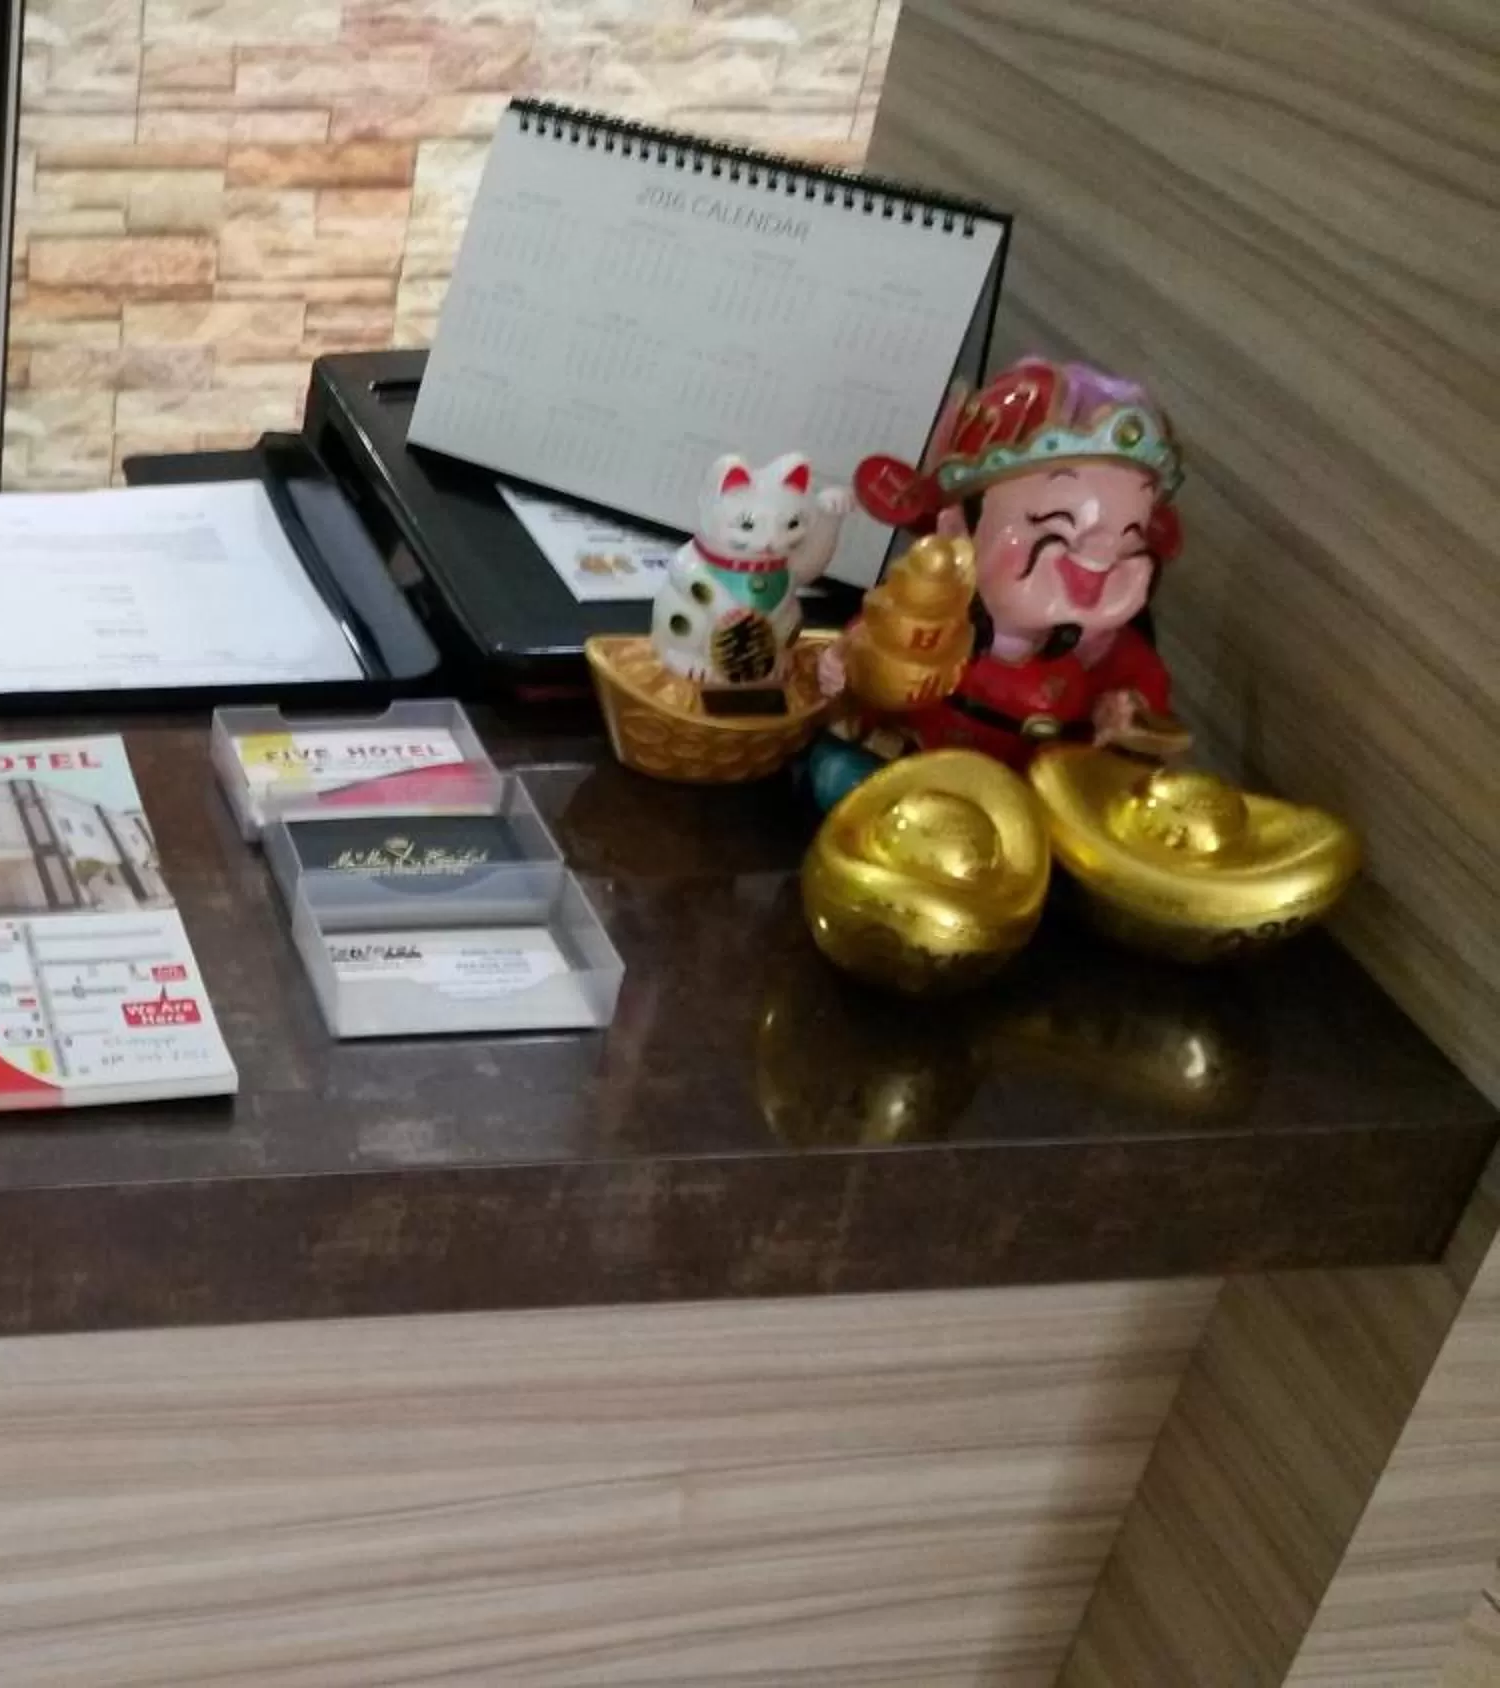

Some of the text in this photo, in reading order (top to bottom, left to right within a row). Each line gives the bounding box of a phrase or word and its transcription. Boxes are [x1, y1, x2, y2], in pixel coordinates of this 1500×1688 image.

[691, 194, 811, 245] CALENDAR
[265, 744, 445, 765] FIVE HOTEL
[125, 1001, 193, 1016] We Are
[141, 1012, 186, 1025] Here
